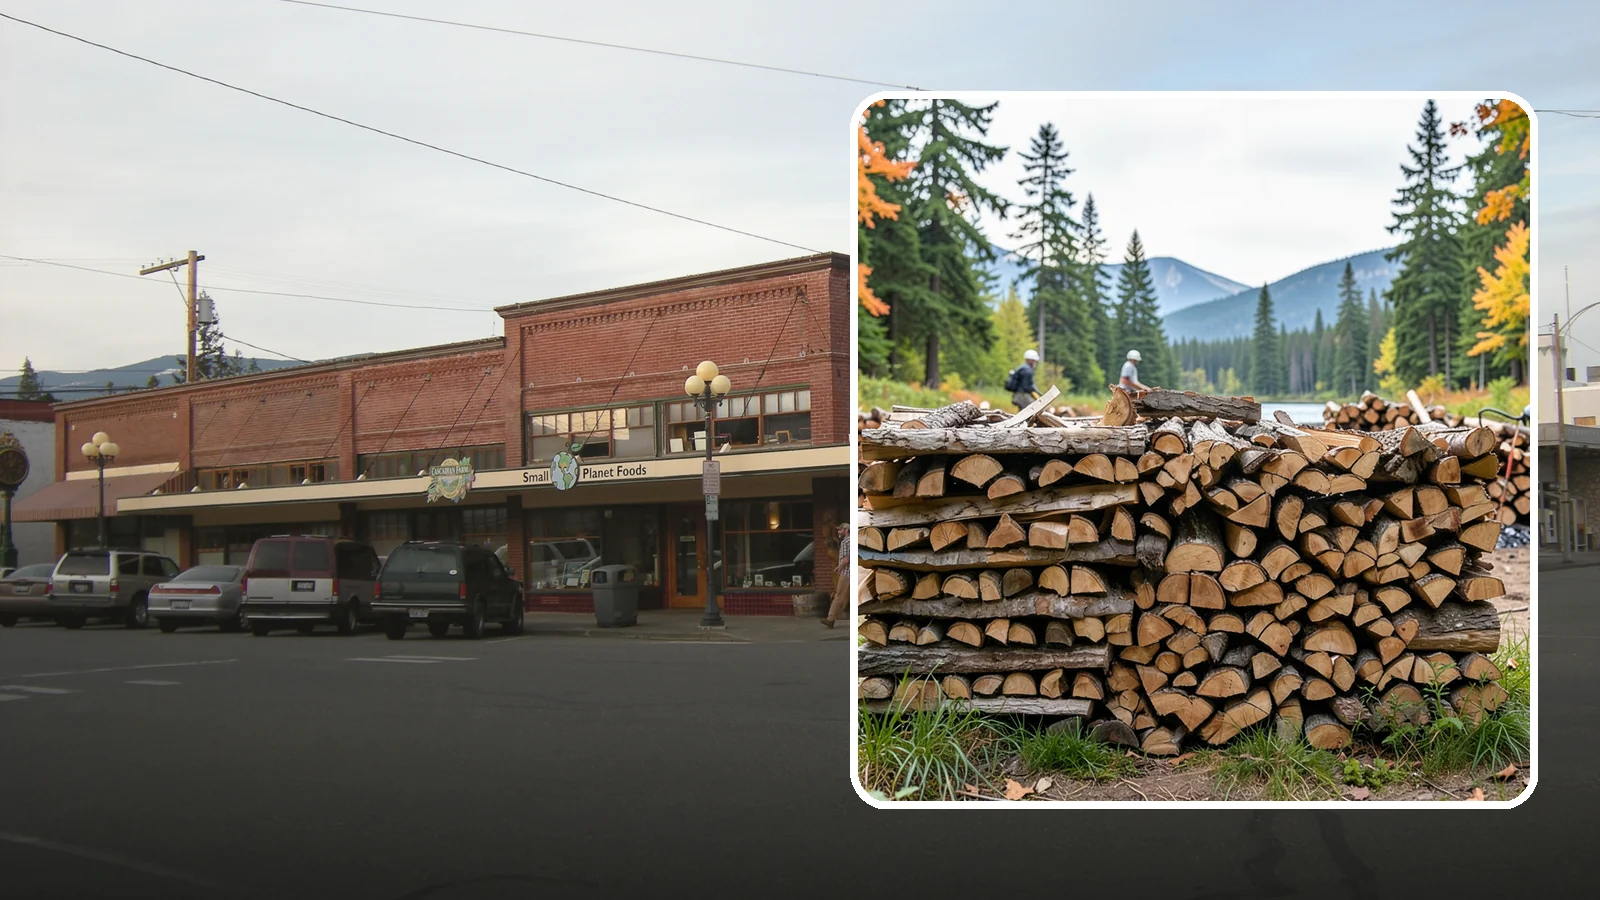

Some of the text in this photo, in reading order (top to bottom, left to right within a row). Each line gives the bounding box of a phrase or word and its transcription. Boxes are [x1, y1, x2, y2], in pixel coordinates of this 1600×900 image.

[523, 464, 647, 483] Small Planet Foods
